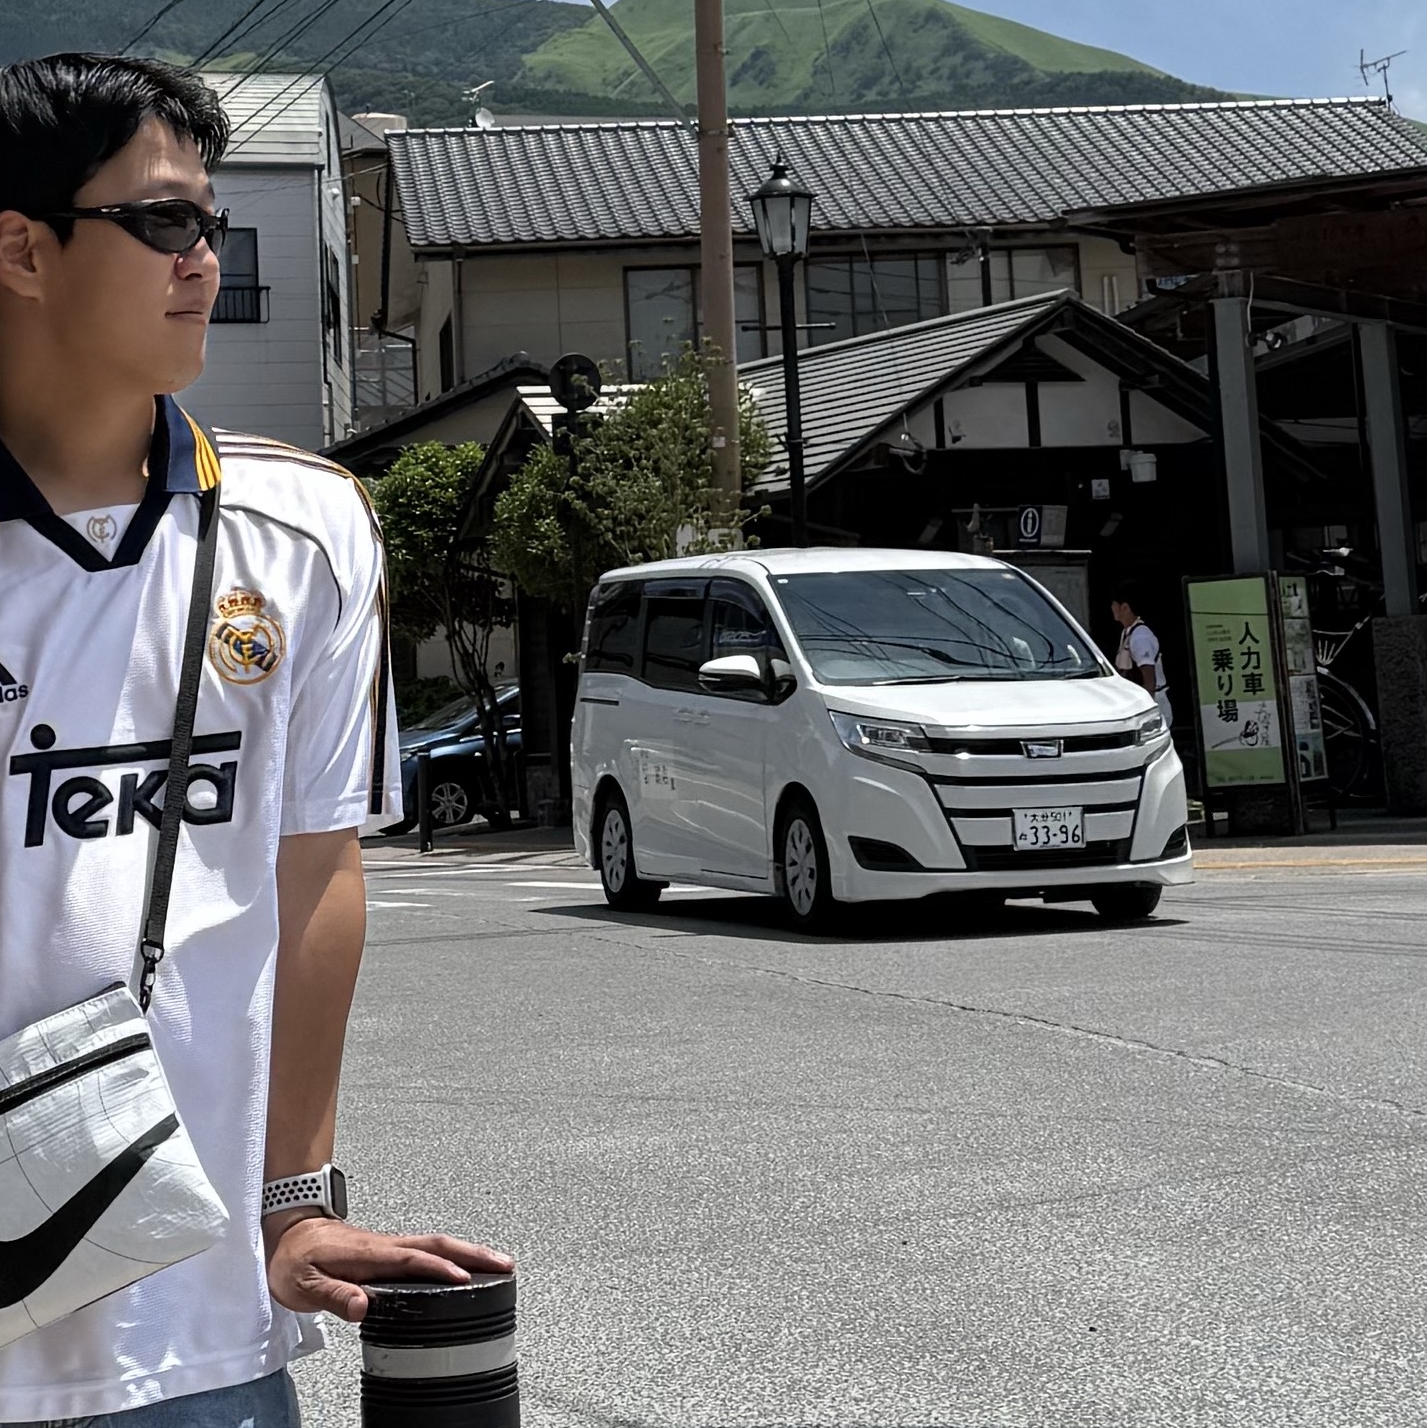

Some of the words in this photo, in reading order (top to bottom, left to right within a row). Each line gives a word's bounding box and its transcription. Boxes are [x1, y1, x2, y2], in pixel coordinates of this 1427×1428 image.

[1212, 648, 1239, 723] 乗り場
[1238, 621, 1265, 696] 人力車
[1029, 824, 1081, 846] 33-96
